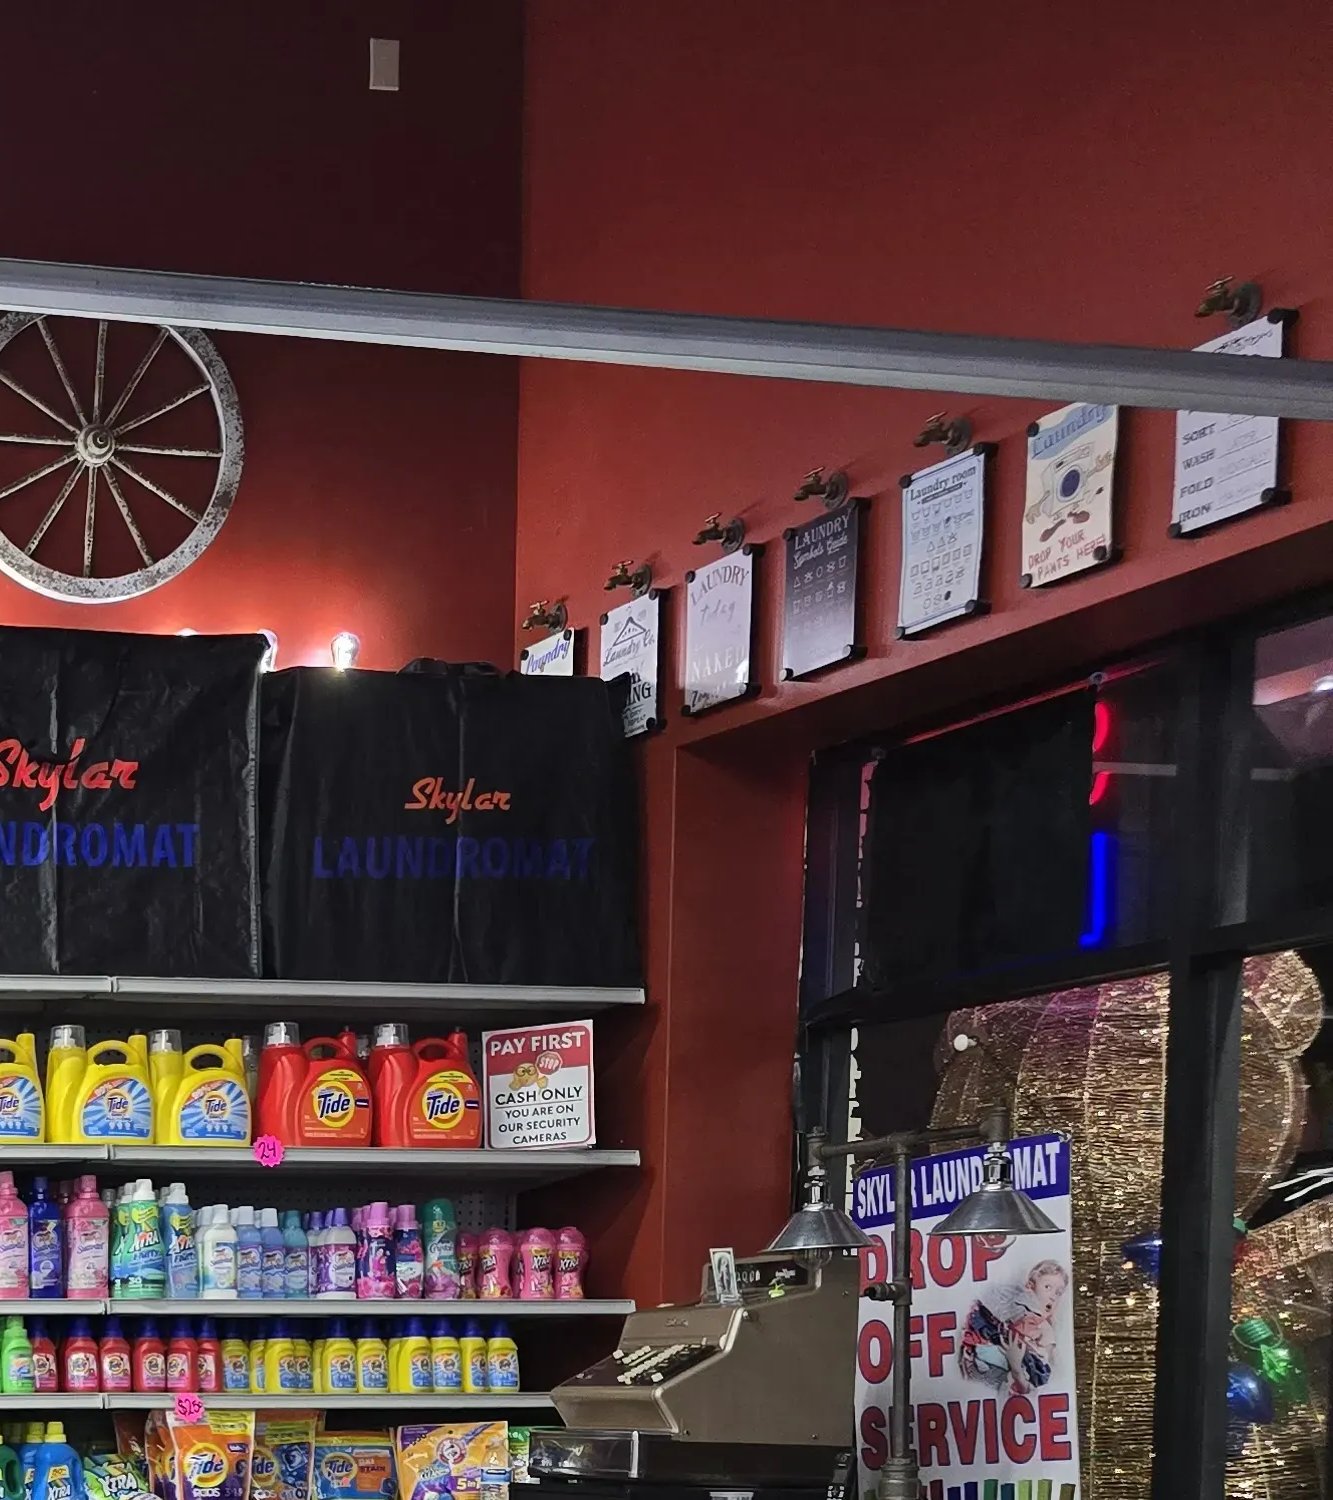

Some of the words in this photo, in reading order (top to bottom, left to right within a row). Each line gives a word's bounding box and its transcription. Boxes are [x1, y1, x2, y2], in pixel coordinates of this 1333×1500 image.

[1182, 449, 1216, 469] WASH
[909, 475, 949, 500] Laundry
[951, 466, 976, 485] room
[1180, 477, 1214, 499] FOLD
[794, 514, 850, 550] LAUNDRY
[1058, 529, 1086, 550] YOUR
[1037, 556, 1070, 580] PANTS
[691, 565, 749, 603] LAUNDRY
[404, 777, 512, 823] Skylar
[312, 836, 600, 881] LAUNDROMAT
[491, 1038, 524, 1057] PAY
[531, 1030, 585, 1052] FIRST
[538, 1056, 560, 1070] STOP
[318, 1094, 350, 1118] Tide
[426, 1094, 460, 1120] Tide
[495, 1090, 539, 1106] CASH
[541, 1086, 583, 1103] ONLY
[505, 1108, 529, 1119] YOU
[532, 1106, 555, 1117] ARE
[557, 1105, 574, 1115] ON
[499, 1121, 524, 1133] OUR
[527, 1117, 581, 1130] SECURITY
[259, 1141, 276, 1159] 24
[512, 1132, 567, 1145] CAMERAS
[858, 1173, 917, 1219] SKYLR
[921, 1142, 1060, 1206] LAUNDMAT
[861, 1393, 1072, 1471] SRVICE
[46, 1482, 71, 1500] XTRA
